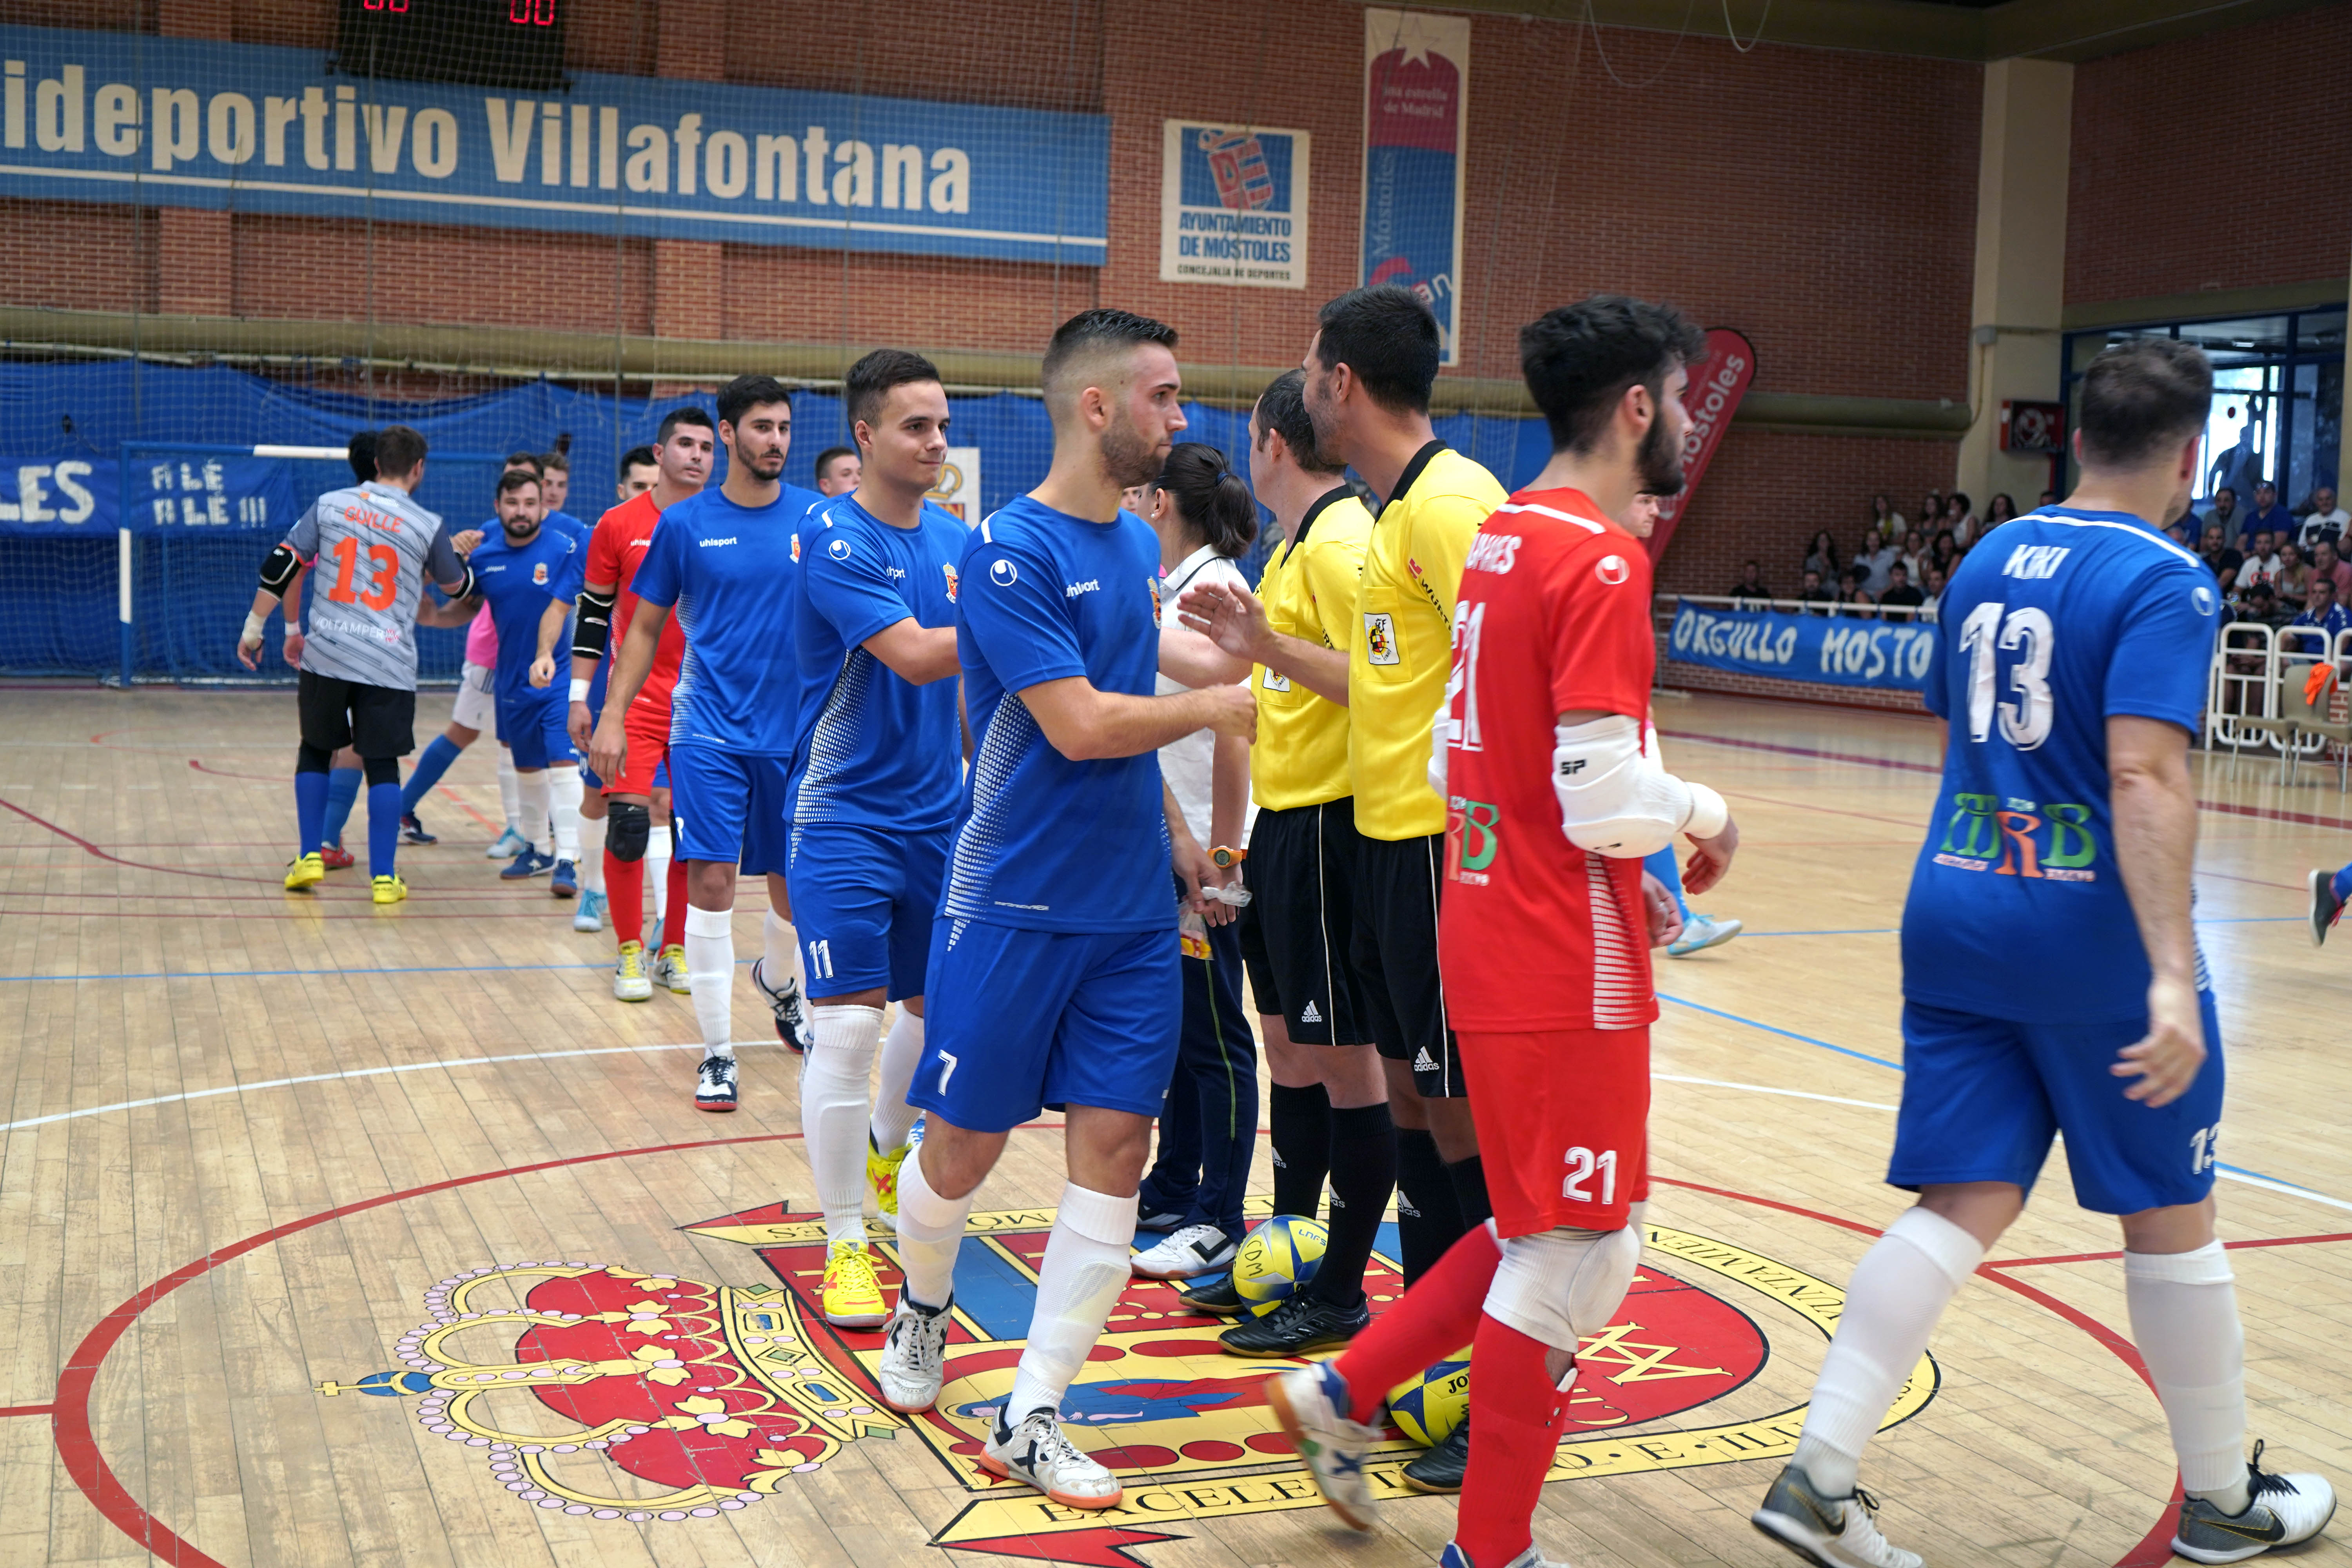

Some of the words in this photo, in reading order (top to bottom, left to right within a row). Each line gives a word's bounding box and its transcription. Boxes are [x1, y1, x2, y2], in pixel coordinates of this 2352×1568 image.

[1405, 87, 1448, 102] estrella
[1383, 101, 1399, 114] de
[1401, 101, 1445, 118] Madrid
[485, 98, 971, 214] Villafontana
[1371, 152, 1396, 257] Móstoles
[1179, 211, 1291, 237] AYUNTAMIENTO
[1180, 234, 1200, 257] DE
[1202, 232, 1290, 263] MÓSTOLES
[1234, 267, 1244, 278] DE
[1247, 268, 1290, 281] DEPORTES
[1681, 354, 1746, 463] ostoles
[344, 506, 404, 533] GUILLE
[699, 536, 738, 548] uhlsport
[328, 536, 400, 612] 13
[1674, 608, 1798, 664] ORGULLO
[1958, 602, 2054, 751] 13
[1561, 759, 1586, 775] SP
[809, 939, 833, 980] 11
[1301, 1014, 1322, 1023] adidas
[937, 1049, 958, 1097] 7
[1414, 1062, 1440, 1072] adidas
[1562, 1146, 1617, 1205] 21
[1357, 1312, 1368, 1325] COPA
